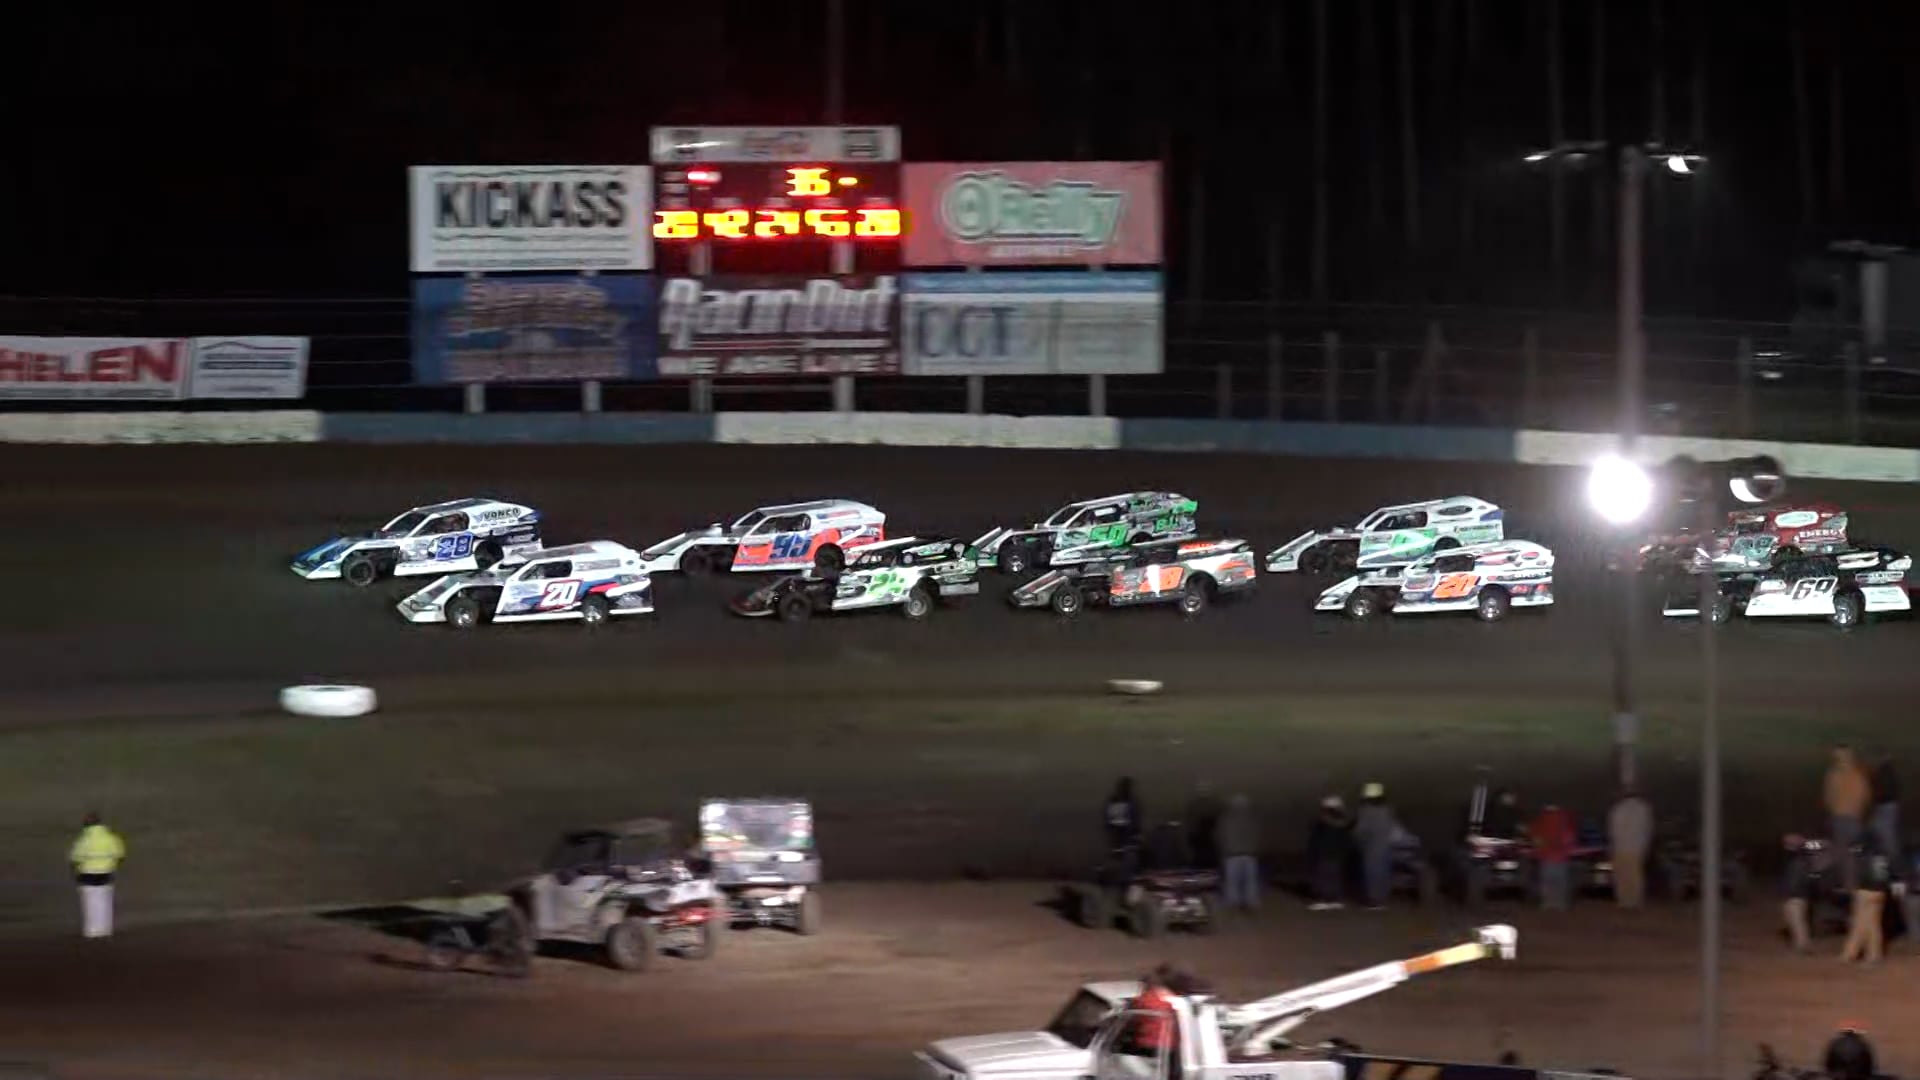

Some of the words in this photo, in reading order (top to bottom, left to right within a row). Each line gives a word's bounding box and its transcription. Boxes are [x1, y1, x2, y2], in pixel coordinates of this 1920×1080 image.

[436, 181, 626, 228] KICKASS
[483, 507, 521, 520] VONCO
[540, 581, 580, 607] 20
